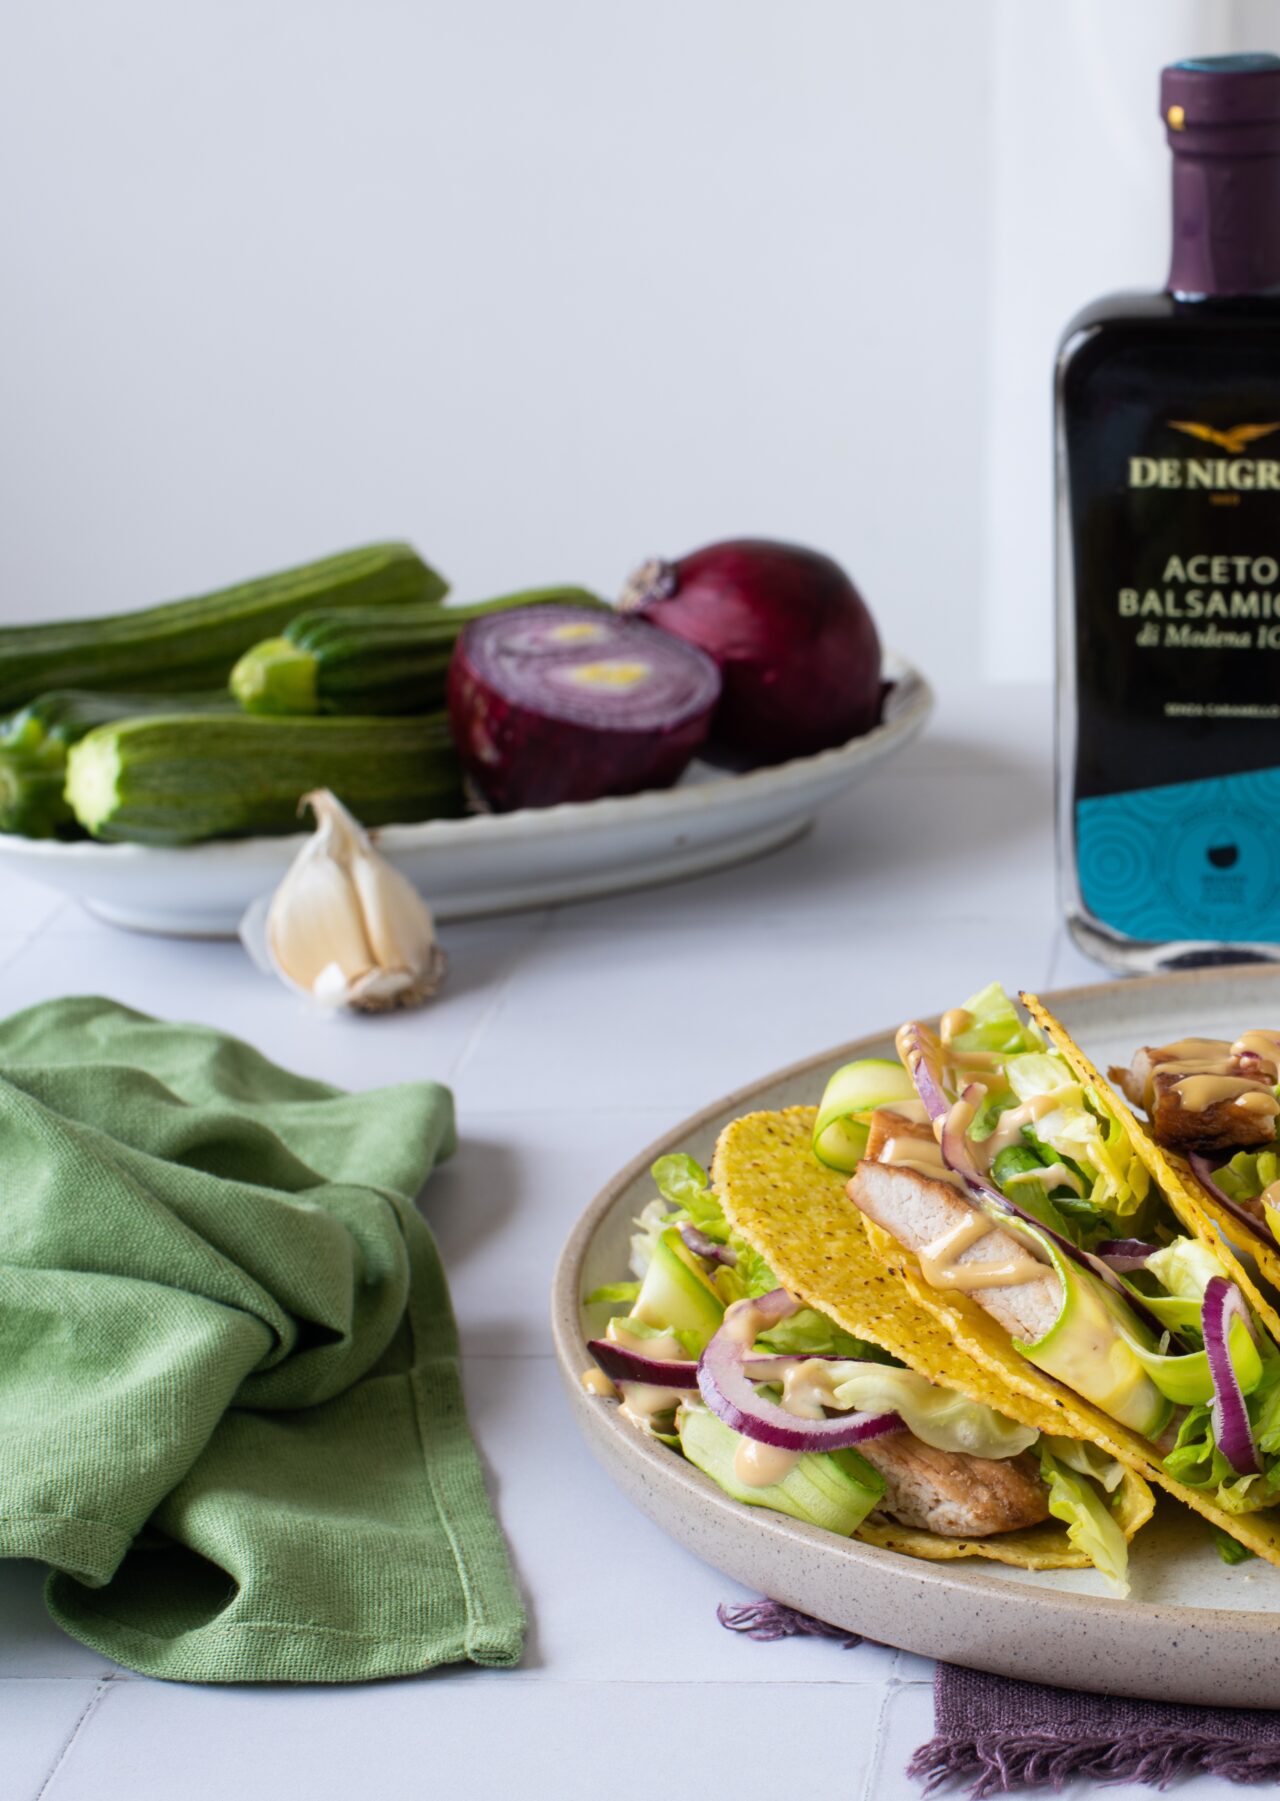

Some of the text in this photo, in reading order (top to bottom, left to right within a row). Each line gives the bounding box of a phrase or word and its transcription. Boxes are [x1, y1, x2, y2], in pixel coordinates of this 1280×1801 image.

[1129, 457, 1182, 488] DE
[1162, 555, 1279, 585] ACETO
[1136, 622, 1159, 647] di
[1164, 623, 1252, 648] Modena
